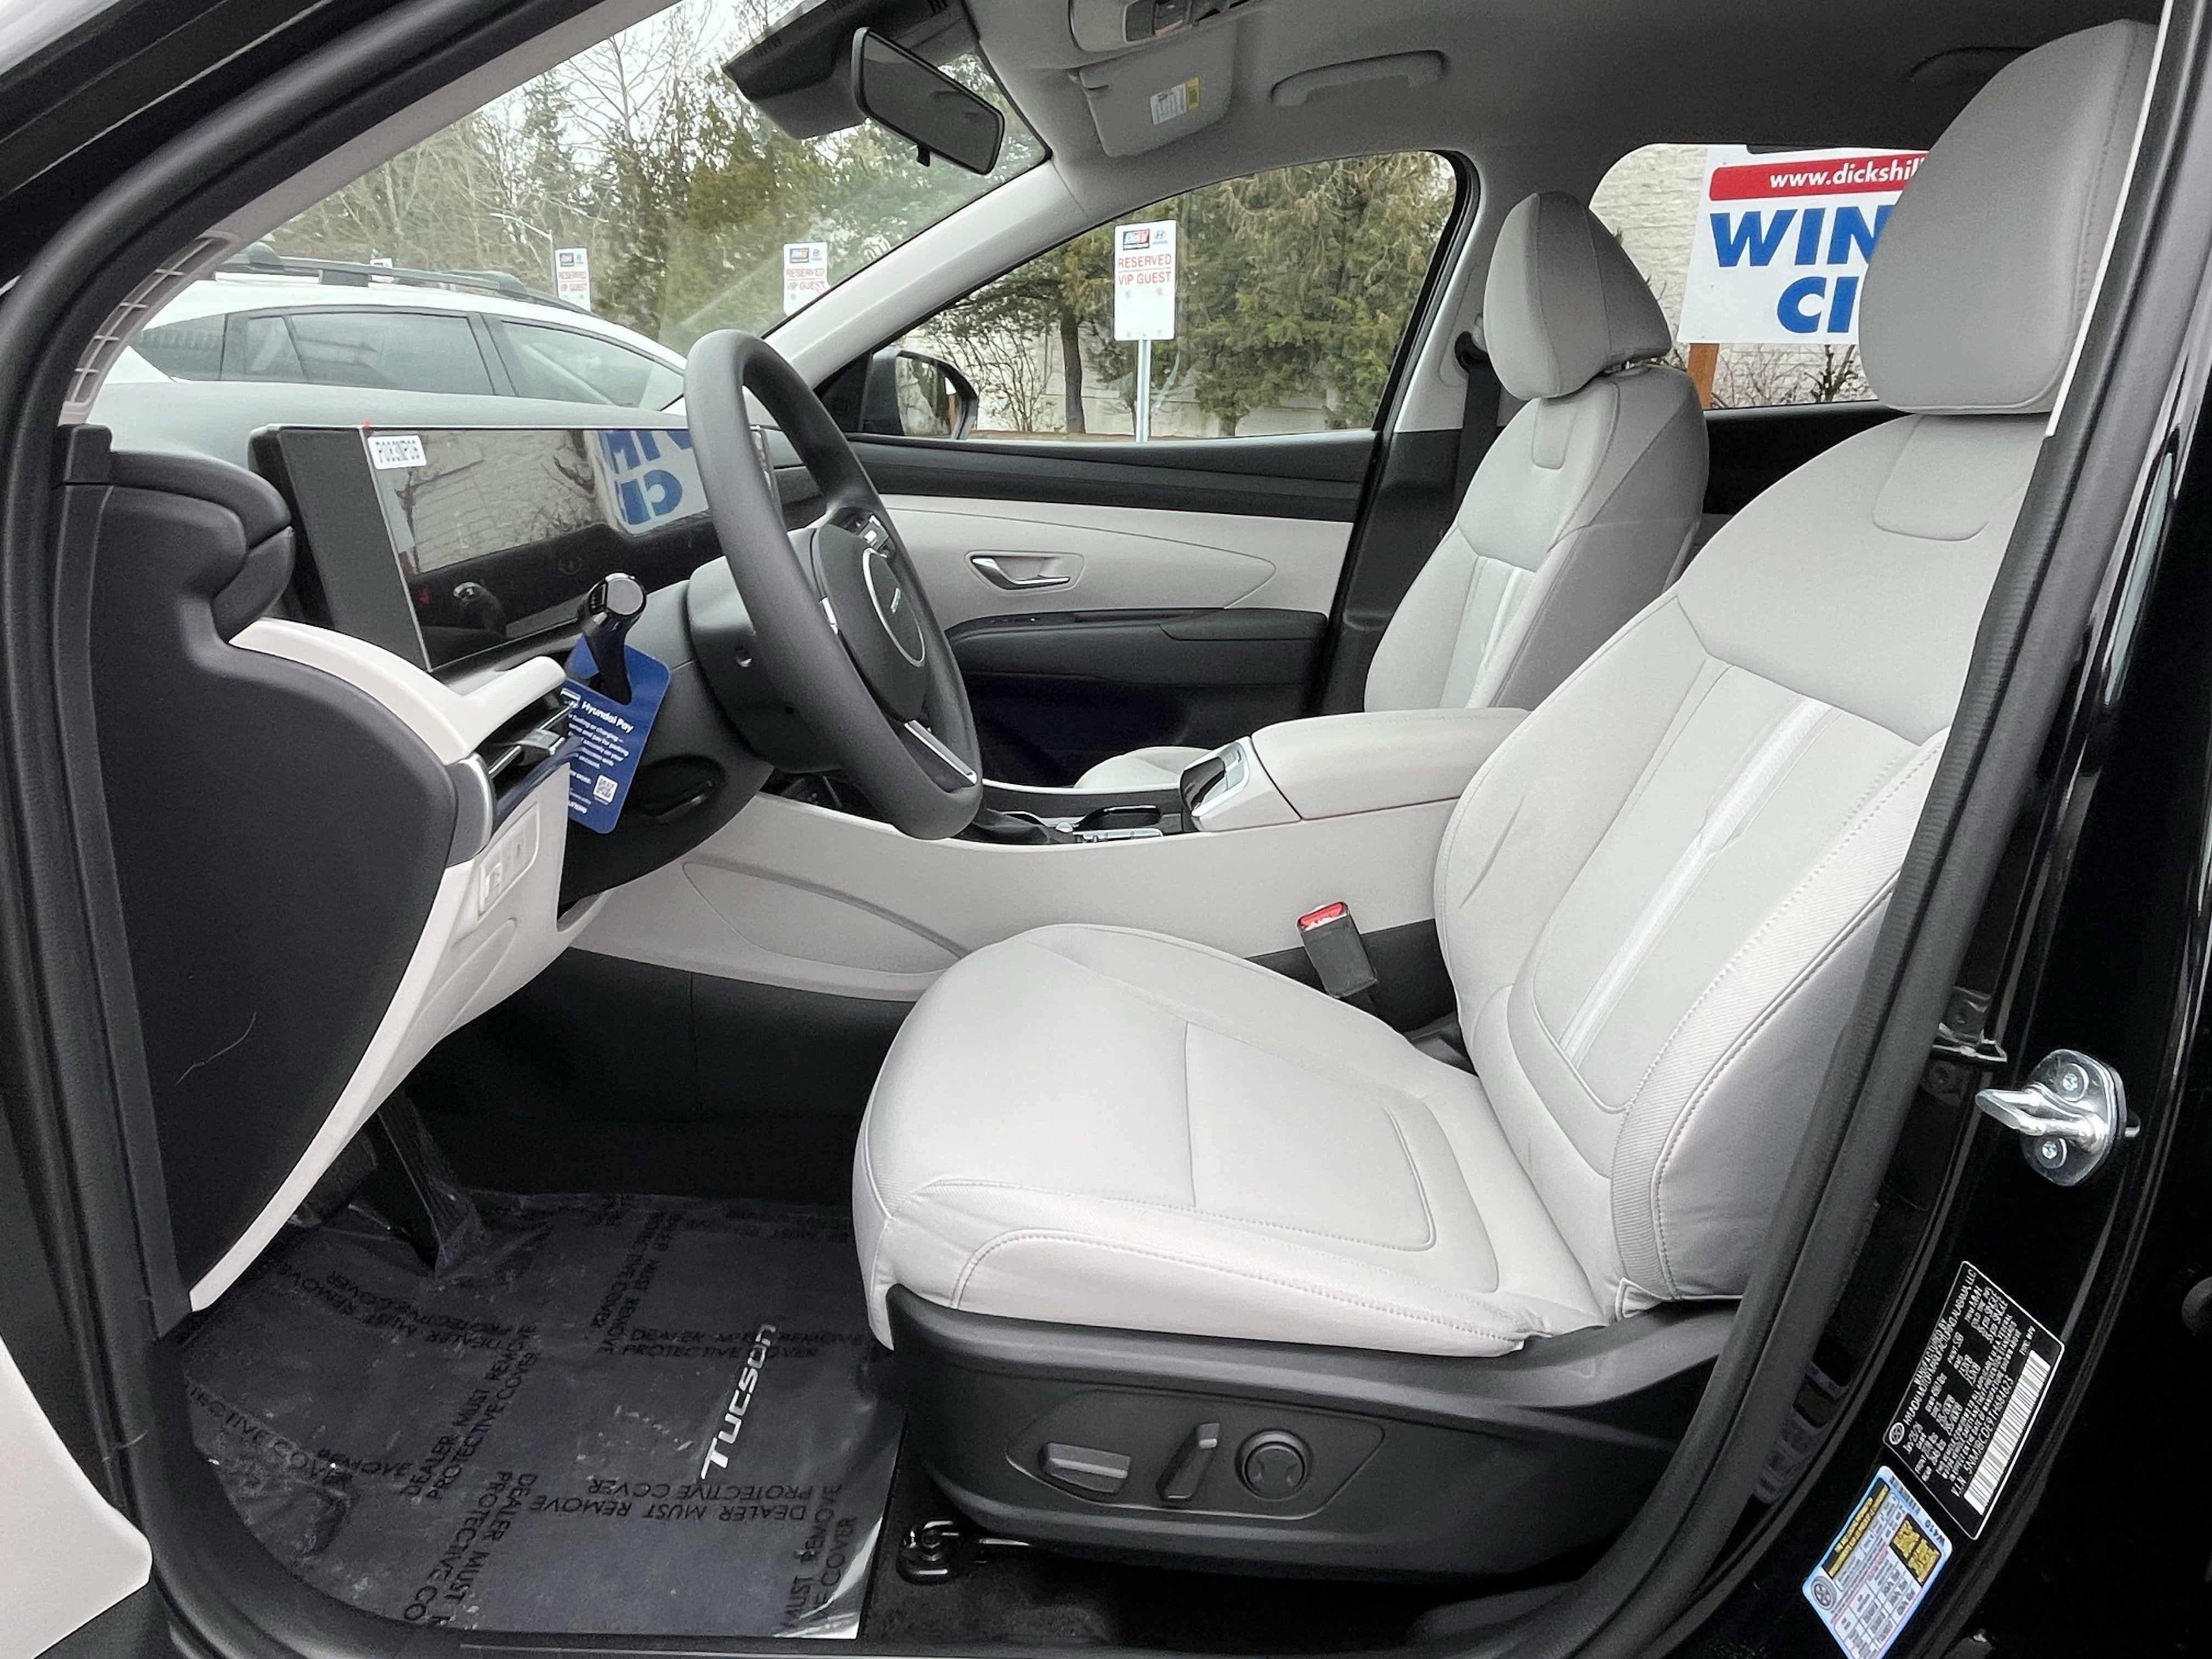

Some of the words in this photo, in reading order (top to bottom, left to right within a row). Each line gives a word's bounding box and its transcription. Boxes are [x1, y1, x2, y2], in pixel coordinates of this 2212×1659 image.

[1770, 157, 1925, 188] www.dickshil
[1118, 253, 1172, 269] RESERVED
[1118, 274, 1134, 286] VIP
[1137, 271, 1172, 285] GUEST
[1777, 276, 1859, 333] CI
[581, 701, 618, 725] Hyundai
[616, 718, 634, 734] Pay
[495, 1351, 541, 1400] COVER
[400, 1433, 459, 1496] DEALER
[483, 1472, 539, 1542] DEALER
[529, 1495, 633, 1518] REMOVE
[673, 1483, 814, 1502] PROTECTIVE
[426, 1470, 514, 1582] PROTECTIVE
[641, 1504, 708, 1521] MUST
[718, 1505, 807, 1522] DEALER
[820, 1515, 858, 1587] COVER
[444, 1549, 492, 1604] MUST
